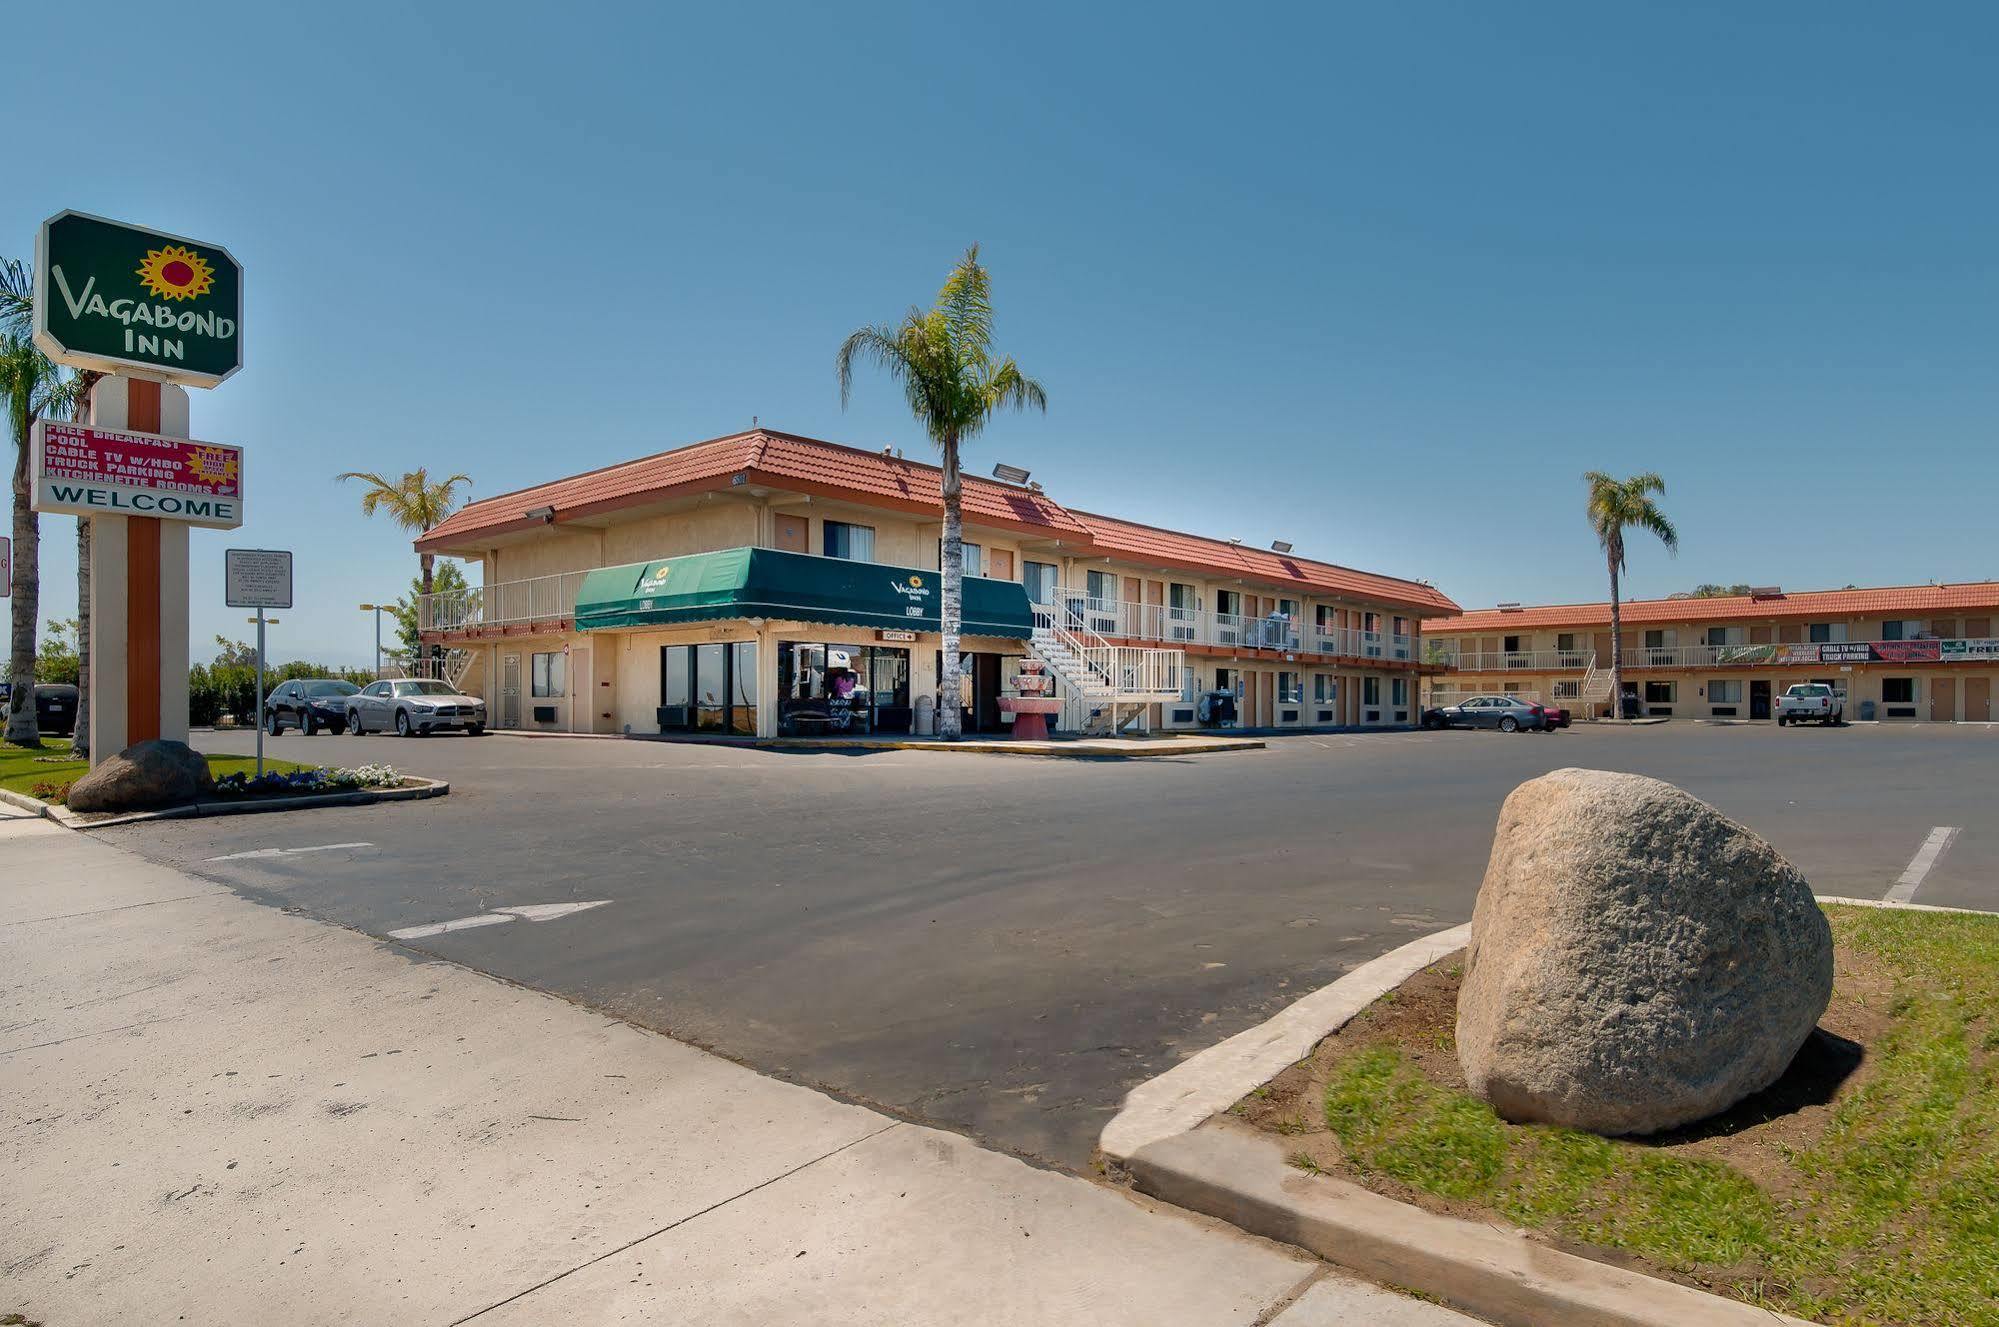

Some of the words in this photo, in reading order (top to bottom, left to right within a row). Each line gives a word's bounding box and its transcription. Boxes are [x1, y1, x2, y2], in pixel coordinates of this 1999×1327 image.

[51, 264, 236, 340] VAGABOND
[124, 329, 184, 361] INN
[46, 424, 85, 437] FREE
[93, 431, 180, 450] BREAKFAST
[46, 434, 89, 448] POOL
[46, 445, 97, 460] CABLE
[104, 451, 123, 463] TV
[129, 456, 183, 471] W/HBO
[46, 456, 99, 471] TRUCK
[107, 463, 175, 480] PARKING
[46, 467, 149, 487] KITCHENETTE
[156, 480, 213, 495] ROOMS
[51, 485, 233, 519] WELCOME
[906, 606, 924, 617] LOBBY
[886, 632, 906, 640] OFFICE
[1822, 652, 1842, 661] TRUCK
